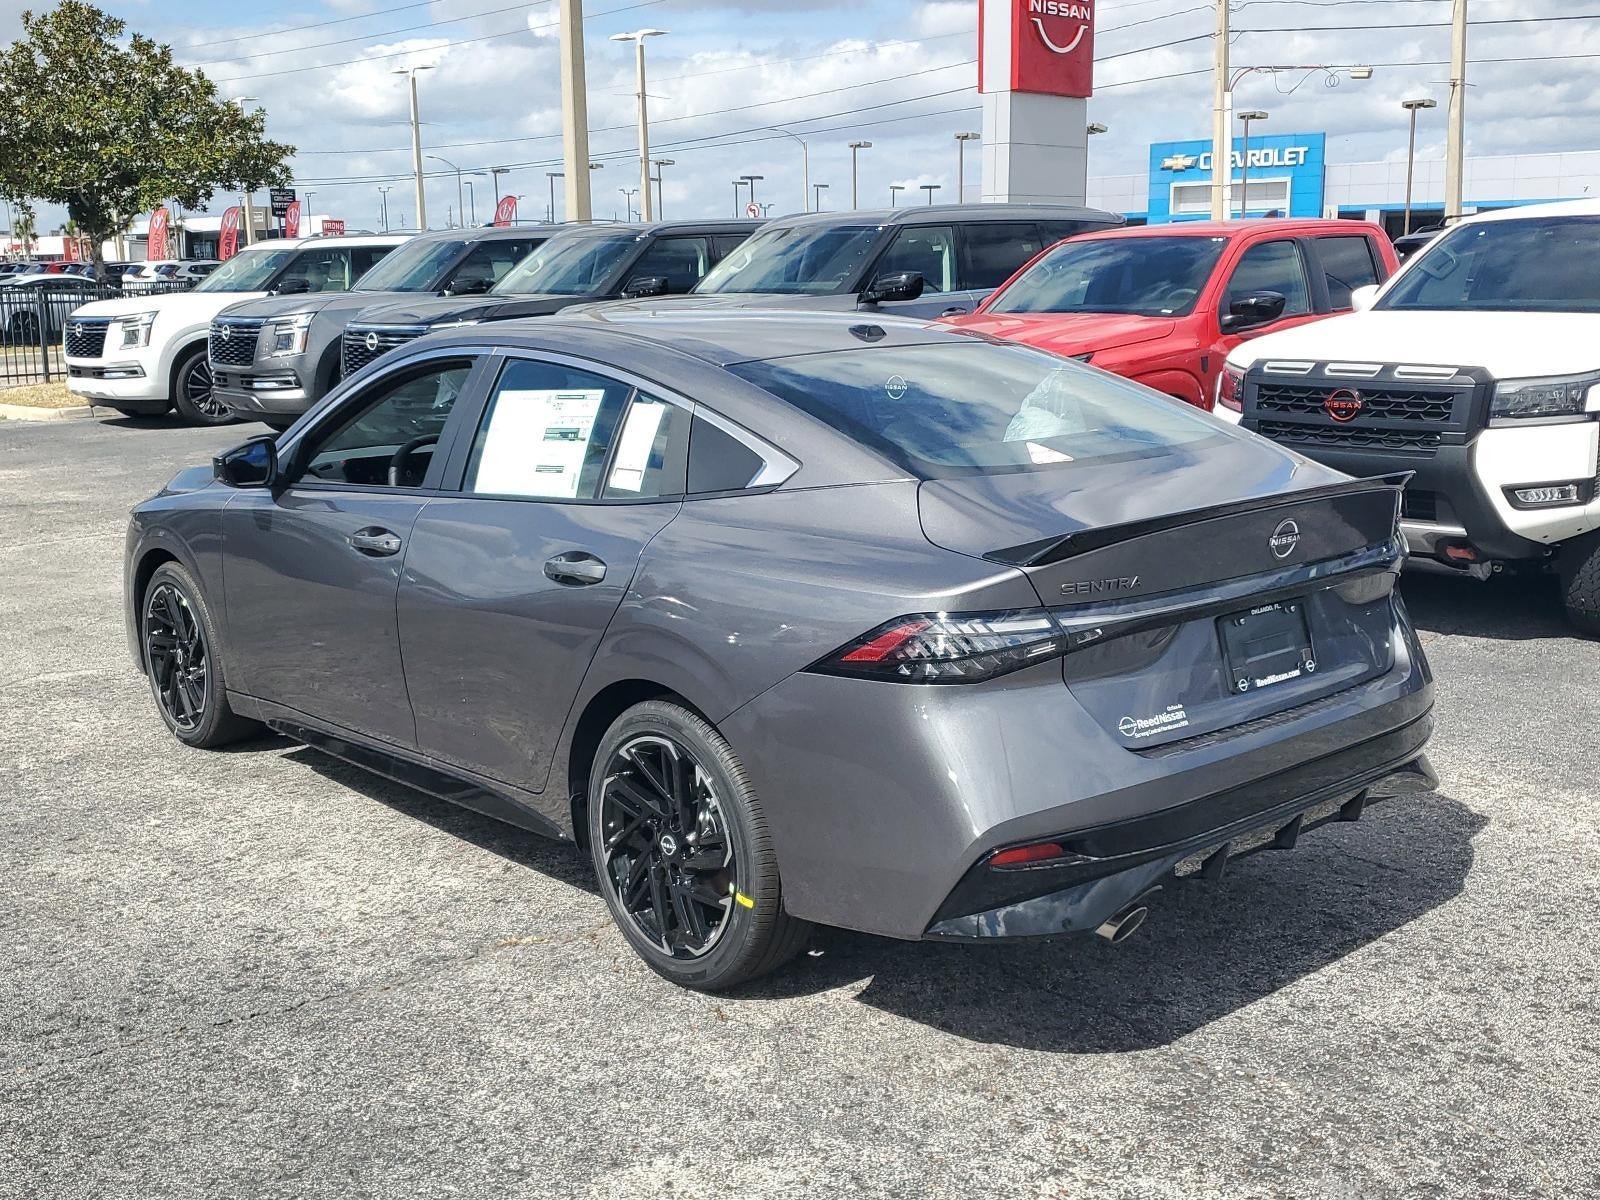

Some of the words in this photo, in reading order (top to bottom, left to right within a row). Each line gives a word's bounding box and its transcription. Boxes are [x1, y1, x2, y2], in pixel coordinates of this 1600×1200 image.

[1029, 0, 1091, 20] NISSAN
[323, 222, 344, 230] WRONG
[1325, 400, 1361, 410] NISSAN
[1270, 534, 1300, 547] NISSAN
[1061, 576, 1140, 595] SENTRA
